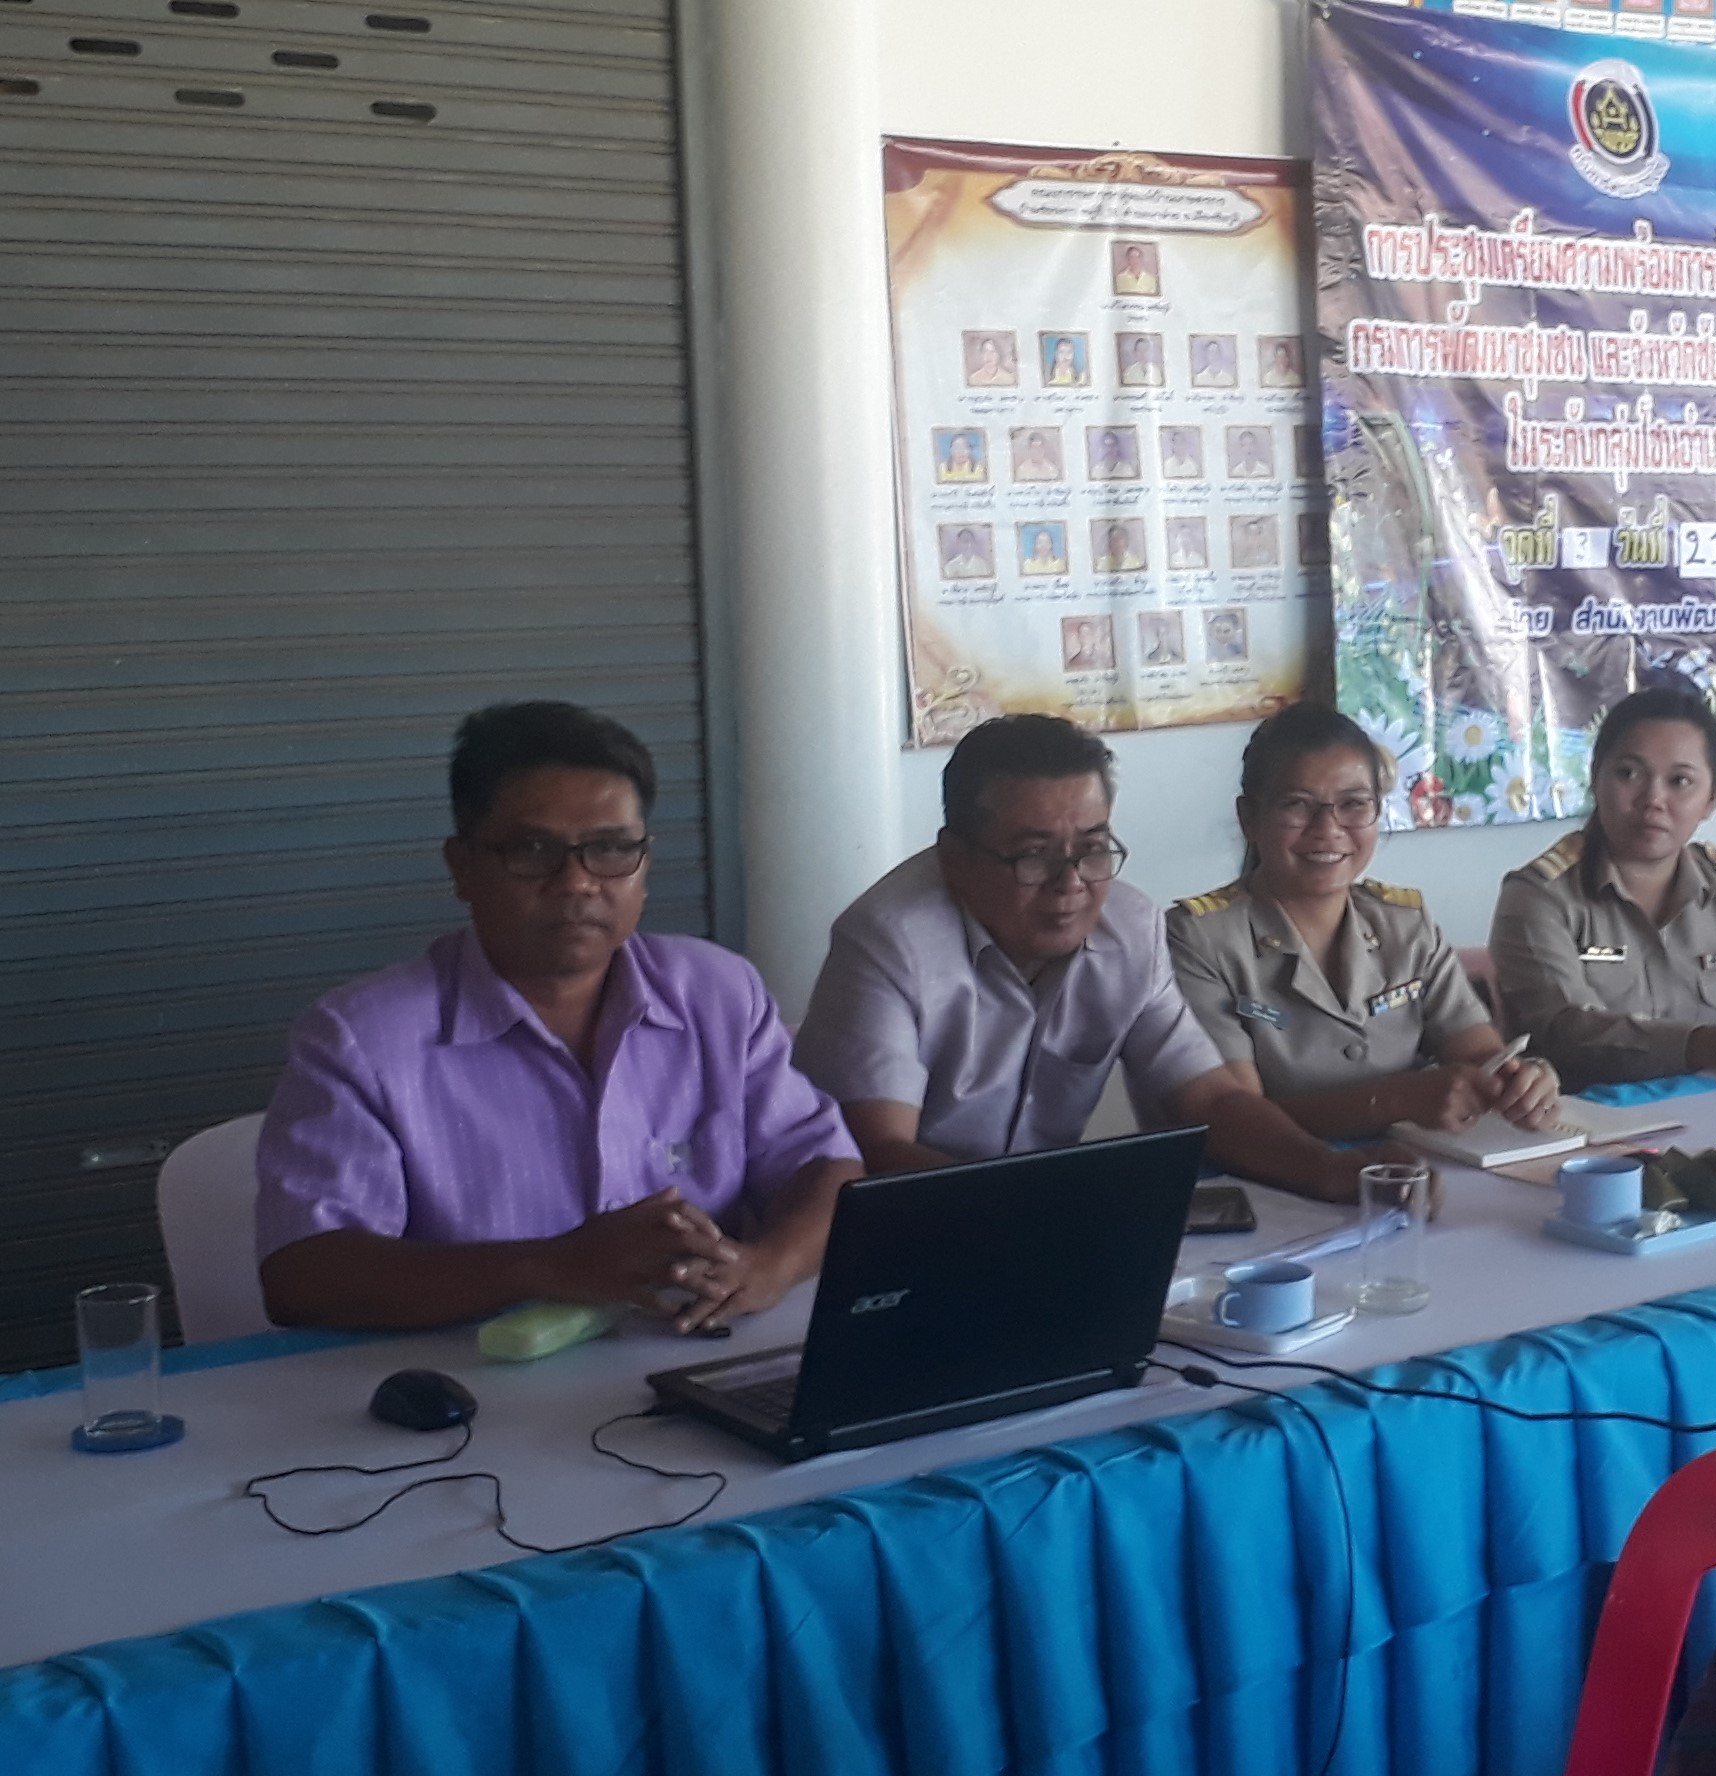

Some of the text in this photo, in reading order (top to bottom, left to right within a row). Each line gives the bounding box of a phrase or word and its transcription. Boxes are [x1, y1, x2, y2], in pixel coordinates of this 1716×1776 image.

[1348, 301, 1588, 400] กรมการพัฒนาชุมชน
[1615, 494, 1669, 569] วันที่
[851, 1289, 911, 1314] acer
